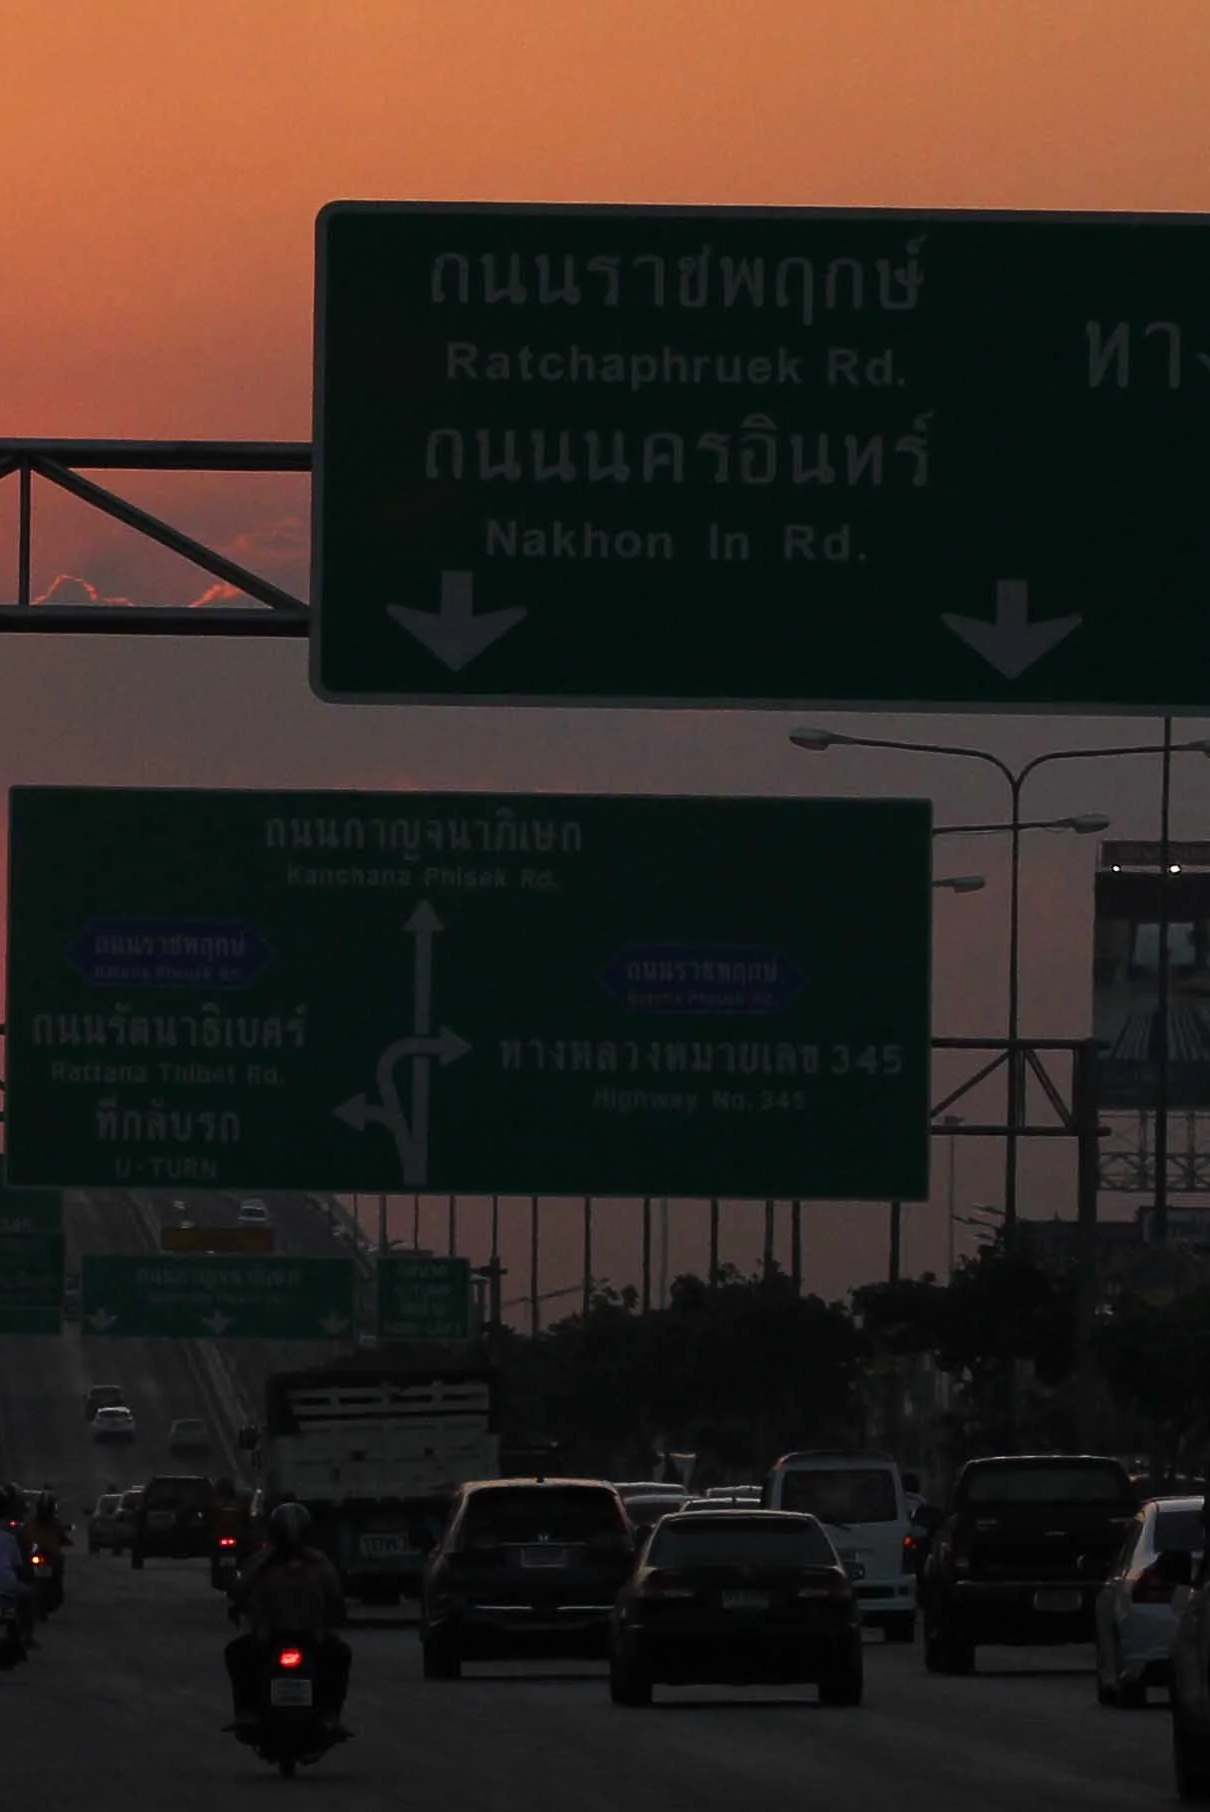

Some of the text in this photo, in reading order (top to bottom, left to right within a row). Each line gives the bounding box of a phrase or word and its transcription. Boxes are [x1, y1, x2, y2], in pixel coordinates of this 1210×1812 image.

[429, 234, 926, 326] ถนนราชพฤกษ์
[446, 342, 907, 392] Ratchaphruek Rd.
[1086, 318, 1210, 391] ทา
[424, 410, 936, 489] ถนนนครอินทร์
[485, 519, 868, 563] Nakhon In Rd.
[265, 806, 583, 862] ถนนกาญจนาภิเษก
[287, 865, 412, 889] Kanchana
[424, 866, 508, 889] Phisek
[31, 1002, 310, 1049] ถนนรัตนาธิเบศร์
[51, 1061, 148, 1084] Rattana
[498, 1036, 903, 1076] ทางหลวงหมายเลข 345
[96, 1093, 240, 1143] ที่กลับรถ
